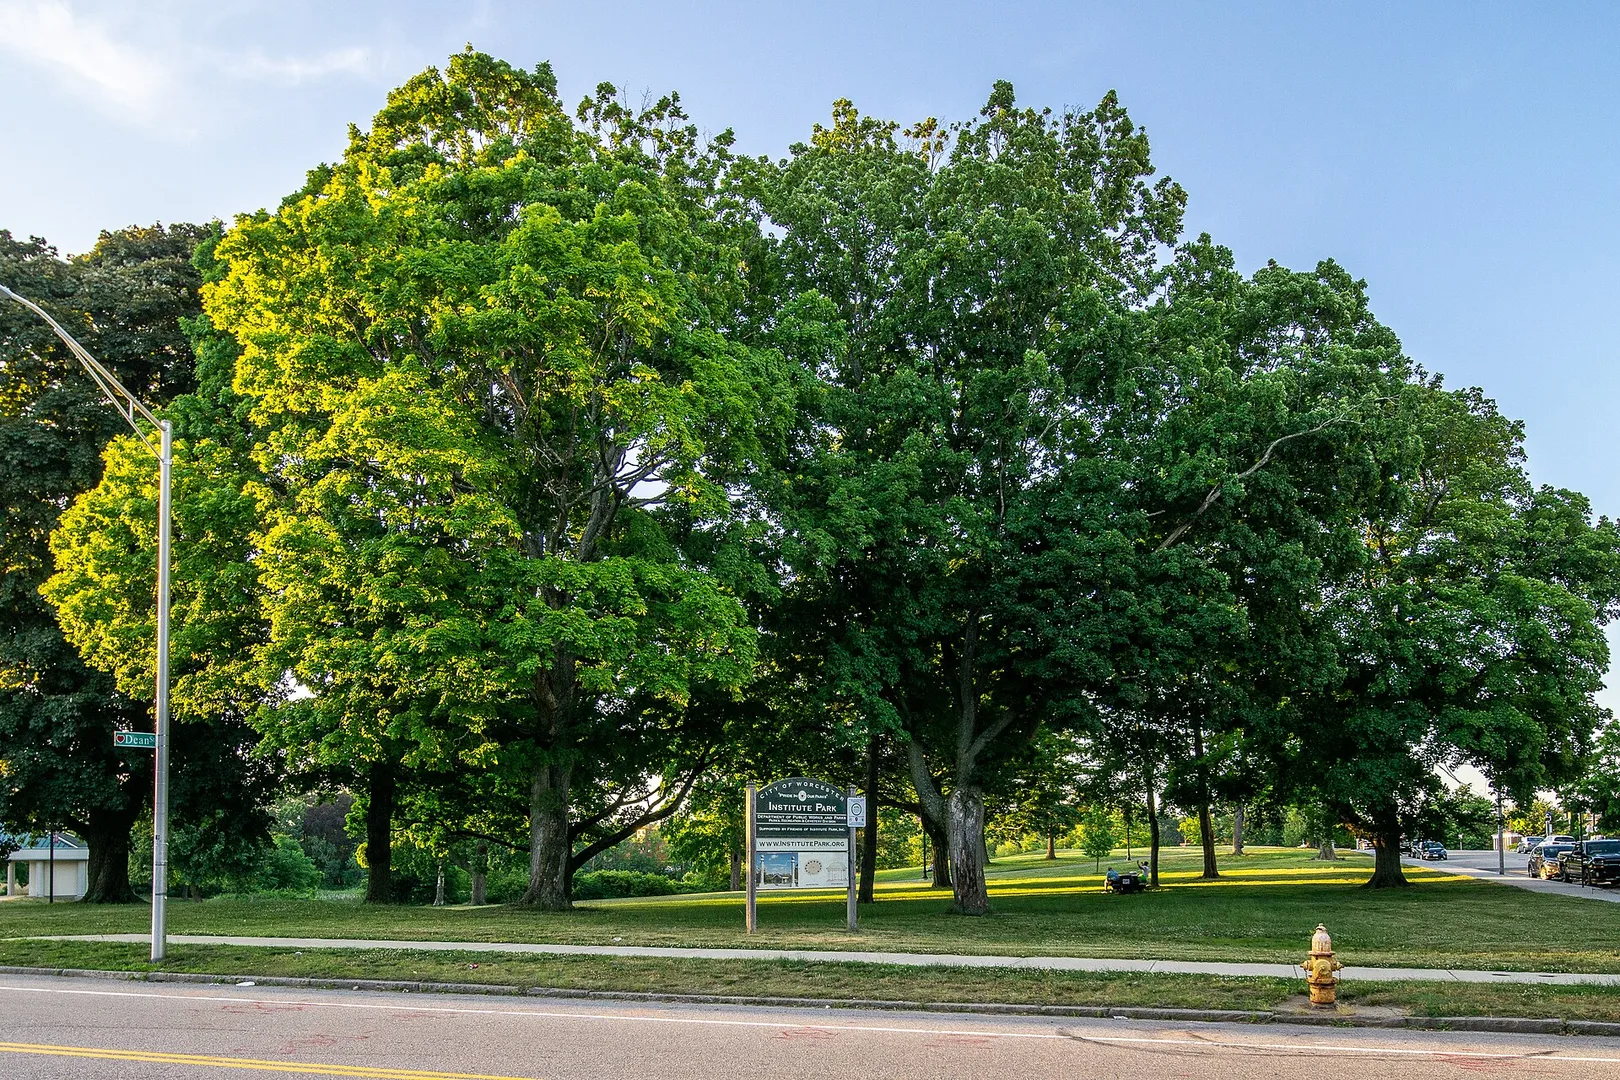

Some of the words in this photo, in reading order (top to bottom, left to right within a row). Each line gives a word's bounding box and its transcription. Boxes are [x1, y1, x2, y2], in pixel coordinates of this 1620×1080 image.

[125, 734, 150, 745] Dean
[760, 786, 778, 799] CITY
[796, 781, 845, 802] WORCESTER
[768, 801, 813, 812] INSTITUTE
[815, 803, 837, 812] PARK
